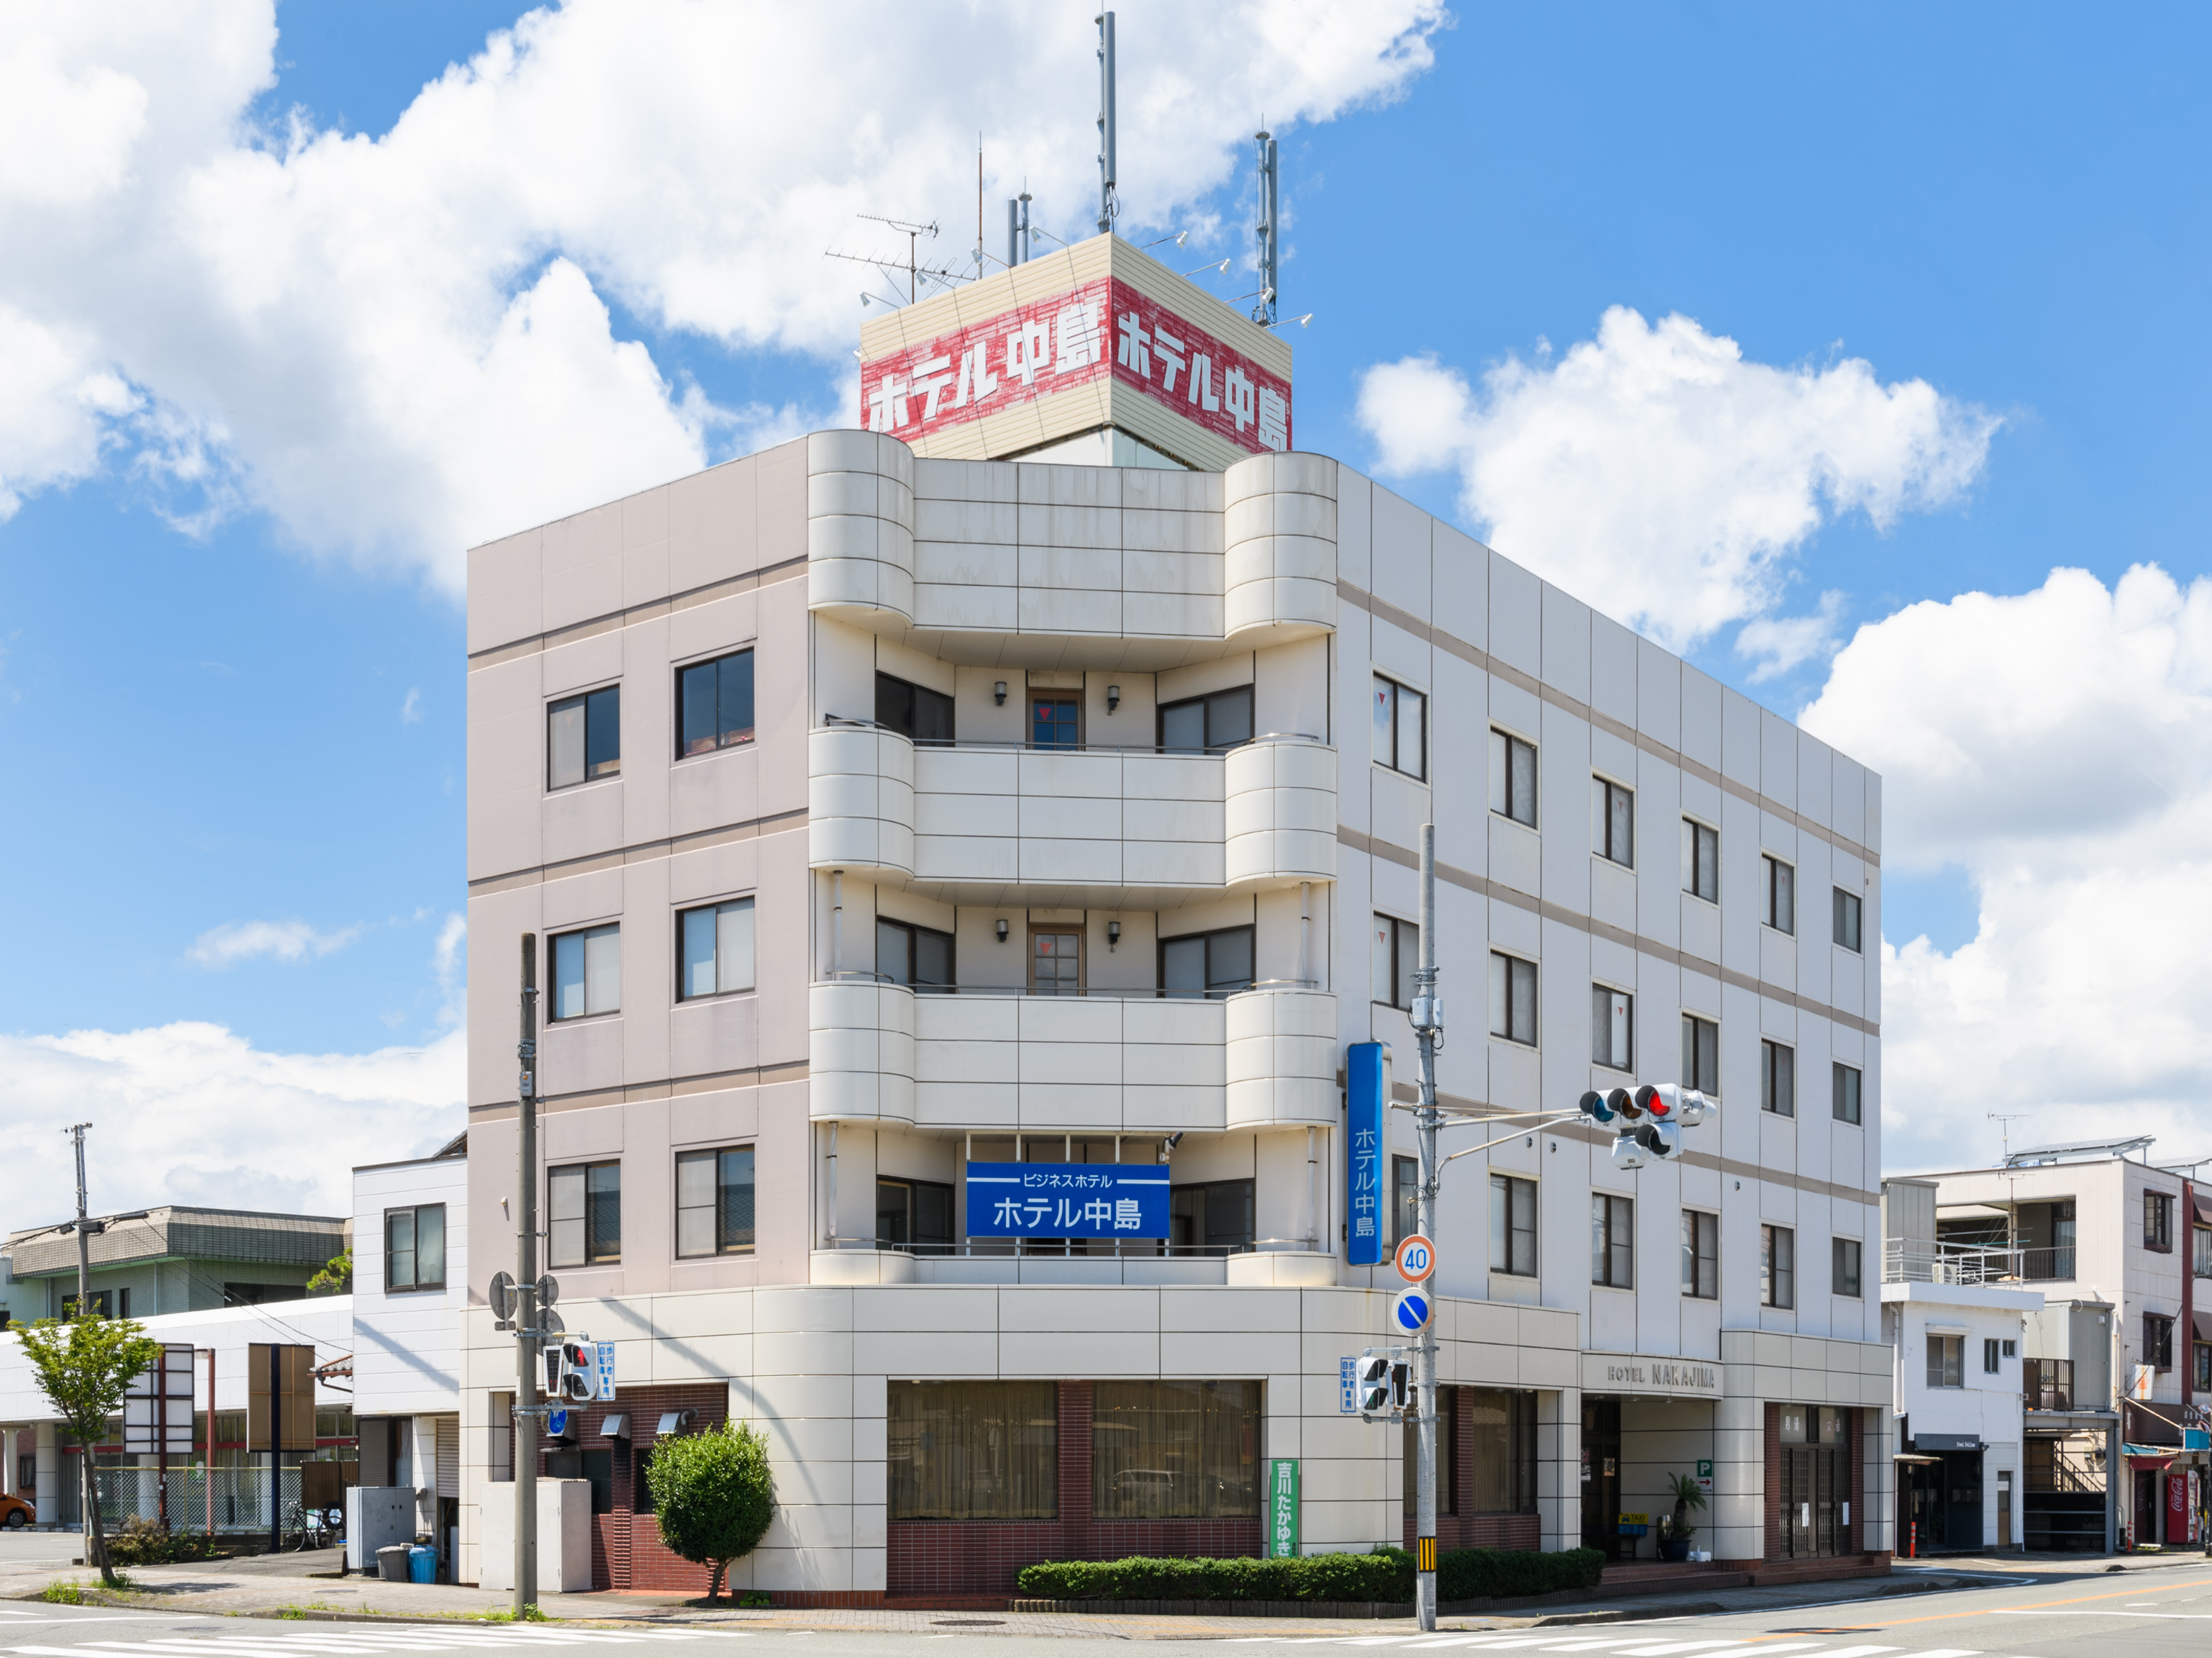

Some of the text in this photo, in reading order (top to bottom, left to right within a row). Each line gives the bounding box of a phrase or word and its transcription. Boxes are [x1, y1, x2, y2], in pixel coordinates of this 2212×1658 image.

[869, 302, 1101, 433] ホテル中島
[1118, 312, 1288, 452] ホテル中島
[1024, 1174, 1112, 1189] ビジネスホテル
[1354, 1128, 1377, 1238] ホテル中島
[994, 1197, 1142, 1231] ホテル中島
[1405, 1249, 1427, 1269] 40
[604, 1377, 609, 1395] 専用
[1608, 1364, 1715, 1388] HOTEL NAKAJIMA
[1346, 1390, 1351, 1408] 専用
[1785, 1415, 1800, 1431] 男湯
[1700, 1462, 1710, 1475] P
[1277, 1462, 1292, 1557] 吉川たかゆき
